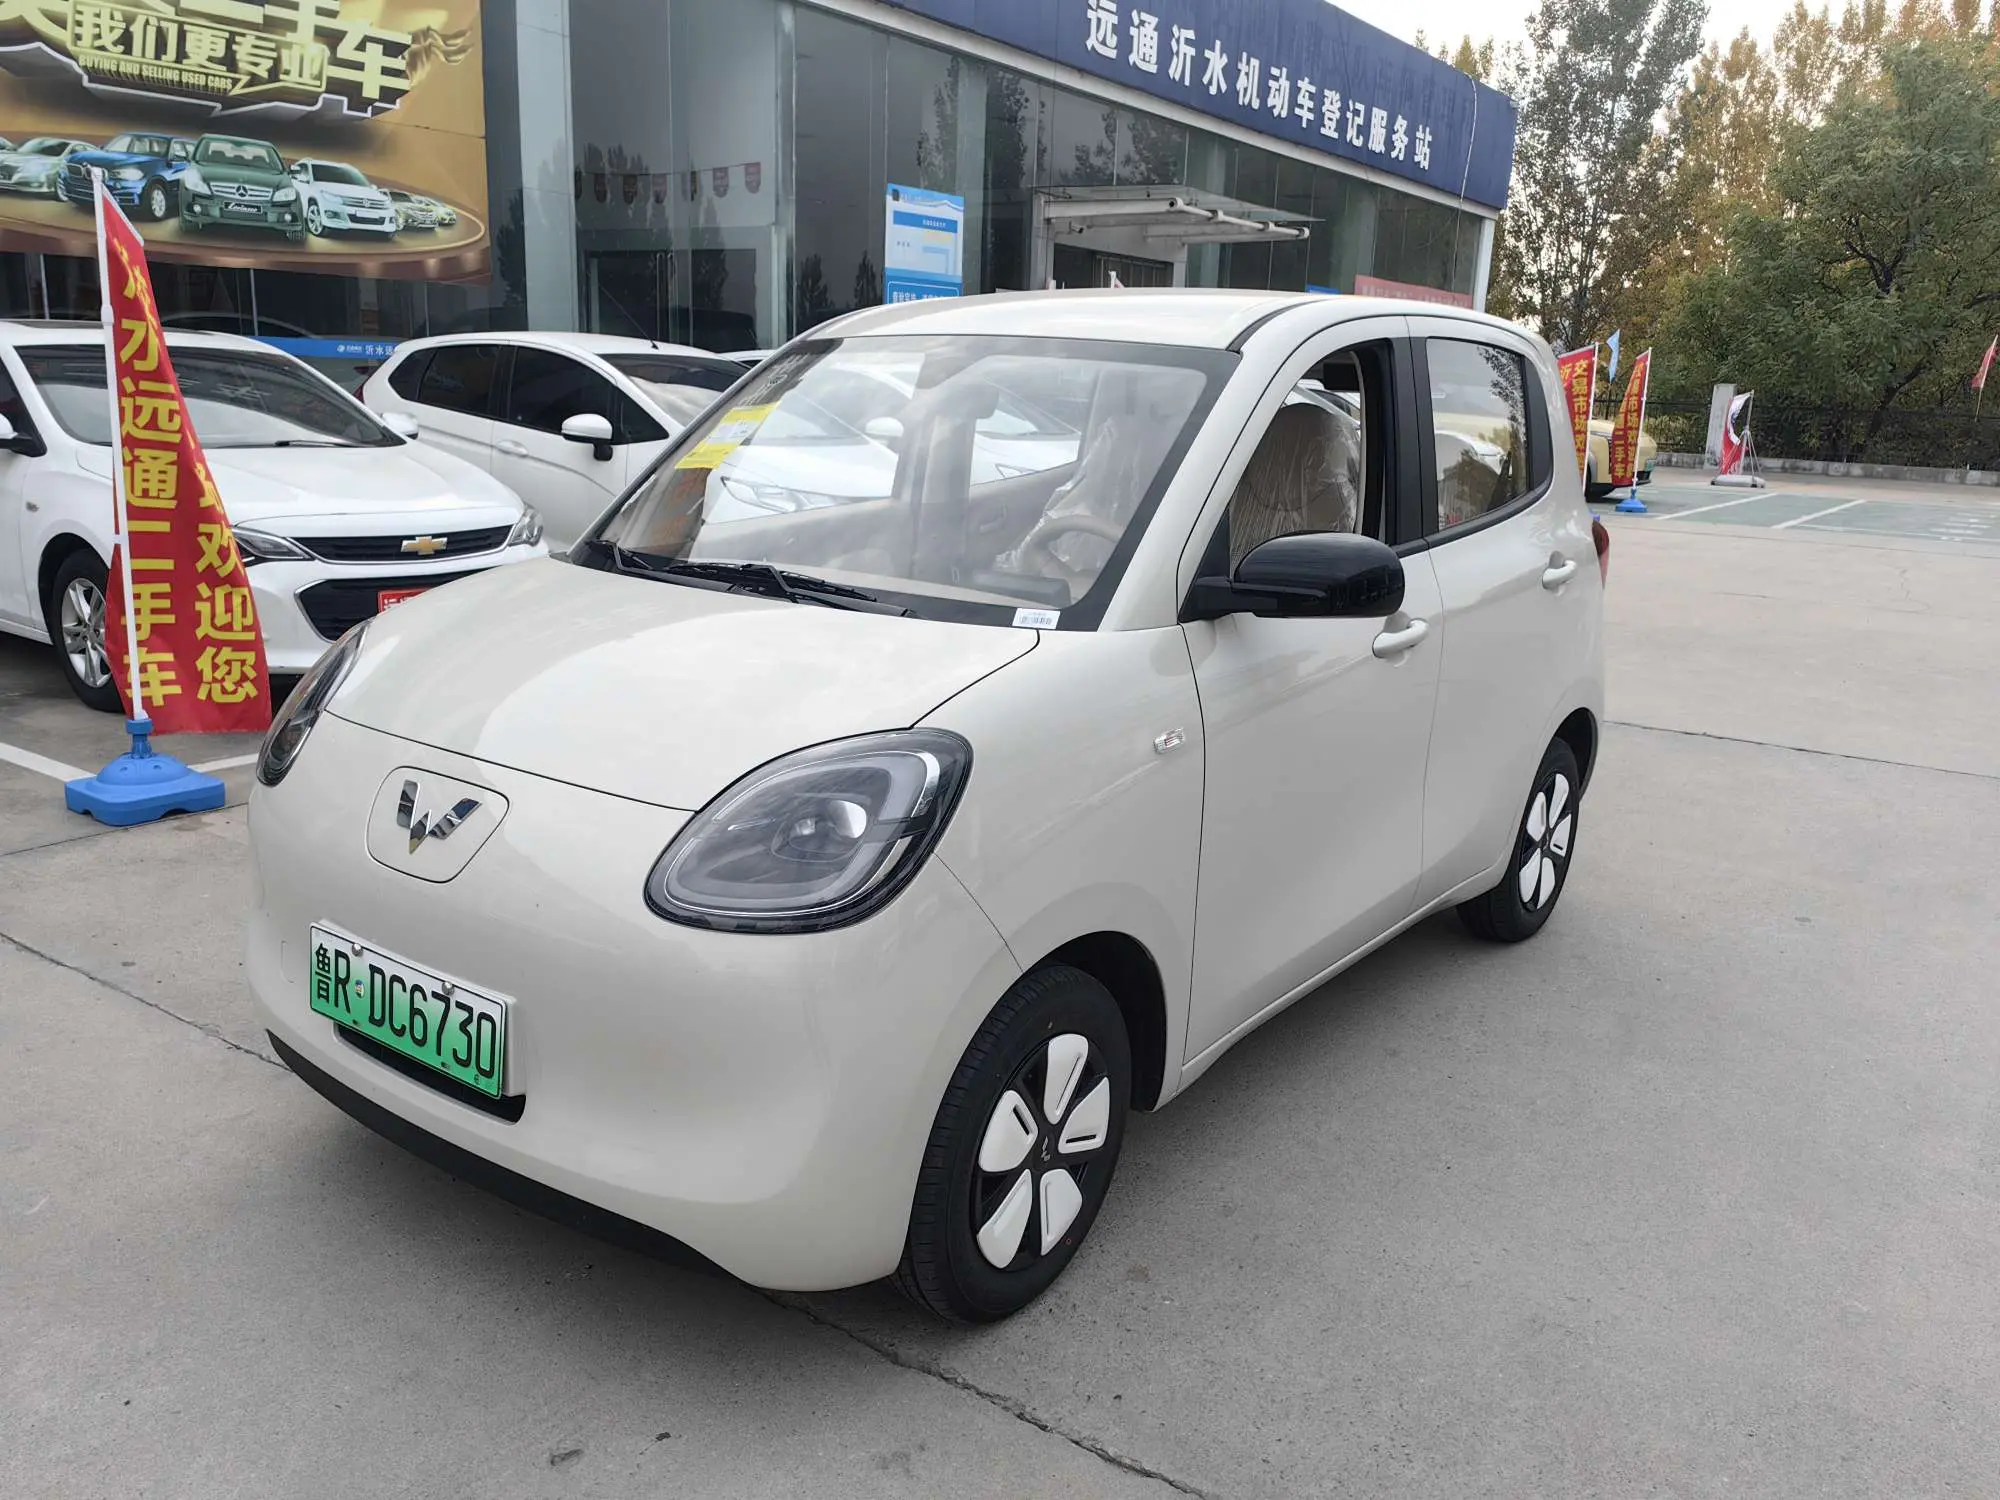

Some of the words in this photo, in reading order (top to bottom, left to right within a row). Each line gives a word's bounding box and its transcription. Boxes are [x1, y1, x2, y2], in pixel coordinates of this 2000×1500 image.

[73, 4, 322, 87] 我们更专业
[79, 55, 117, 73] BUYING
[119, 61, 140, 75] AND
[142, 65, 180, 83] SELLING
[182, 72, 206, 86] USED
[208, 76, 233, 90] CARS
[1086, 0, 1432, 170] 远通沂水机动车登记服务站
